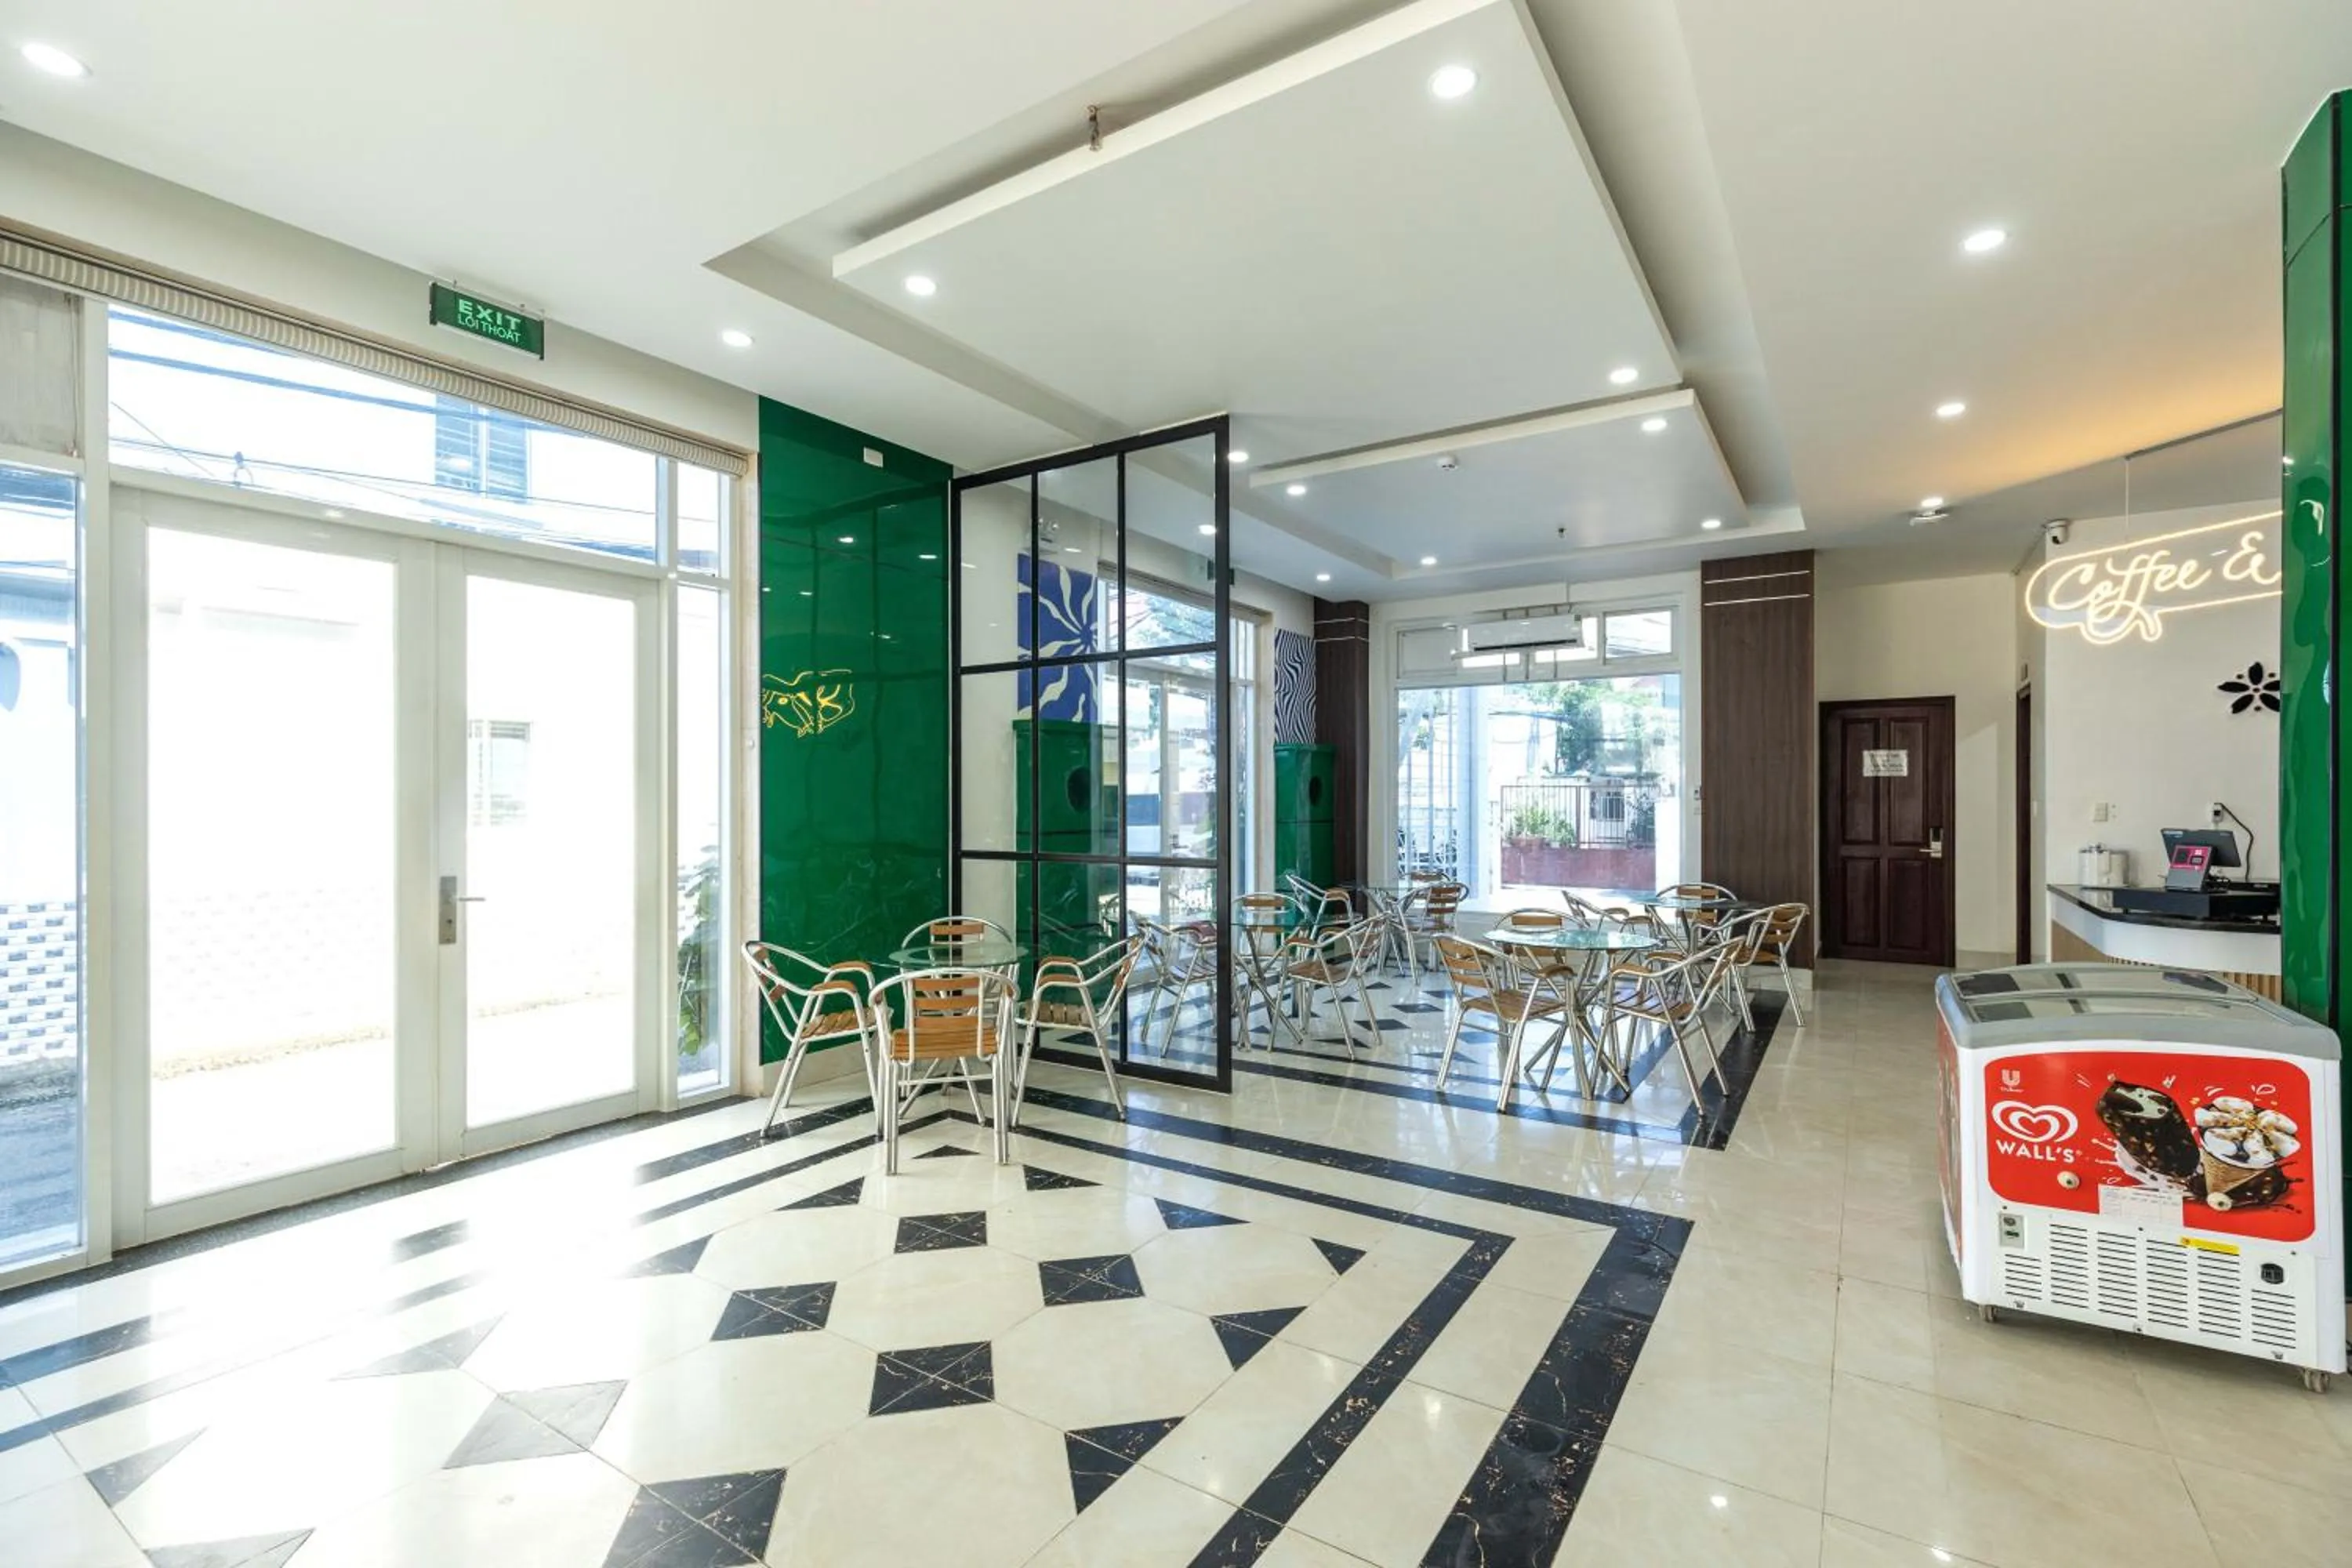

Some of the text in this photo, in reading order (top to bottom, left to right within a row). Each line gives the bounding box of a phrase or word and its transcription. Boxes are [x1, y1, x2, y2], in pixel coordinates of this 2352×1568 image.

[459, 299, 521, 330] EXIT
[2048, 532, 2282, 637] Coffee &
[1995, 1139, 2075, 1163] WALL'S
